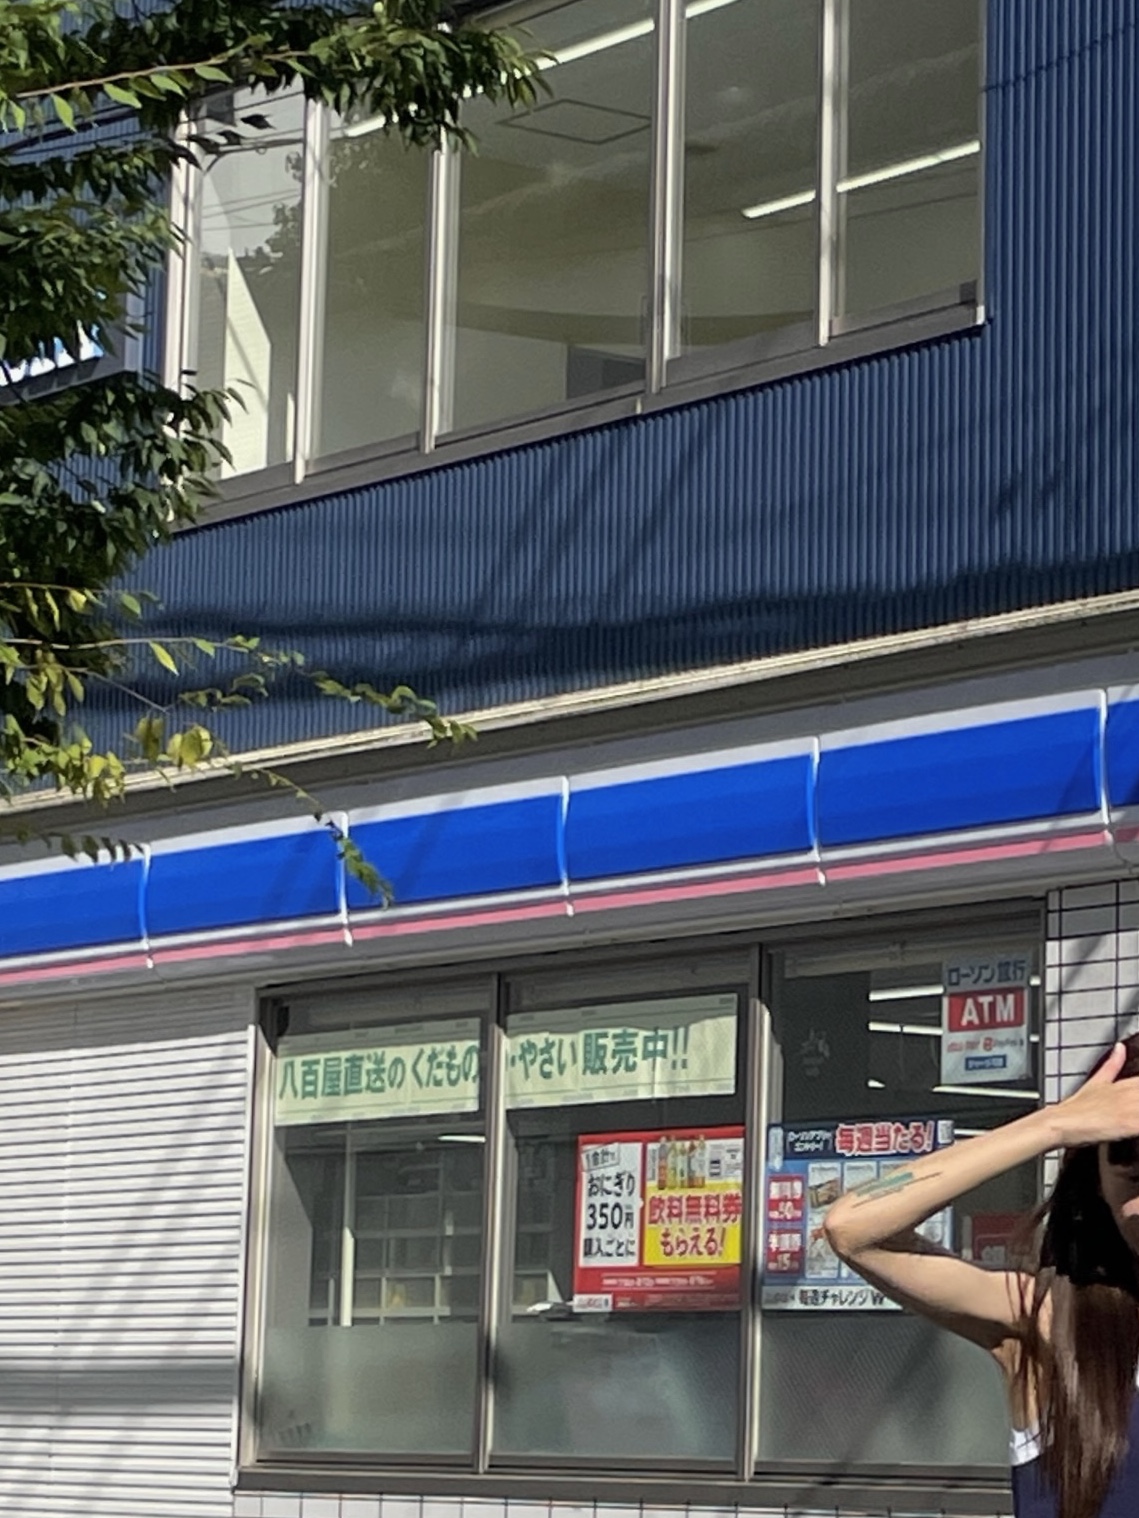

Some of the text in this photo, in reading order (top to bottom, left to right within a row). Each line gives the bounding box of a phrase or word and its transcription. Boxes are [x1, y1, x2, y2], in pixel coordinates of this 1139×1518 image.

[960, 993, 1015, 1027] ATM
[588, 1171, 636, 1198] おにぎり
[586, 1202, 634, 1230] 350円
[648, 1192, 742, 1225] 飲料無料券
[660, 1227, 726, 1258] もらえる!
